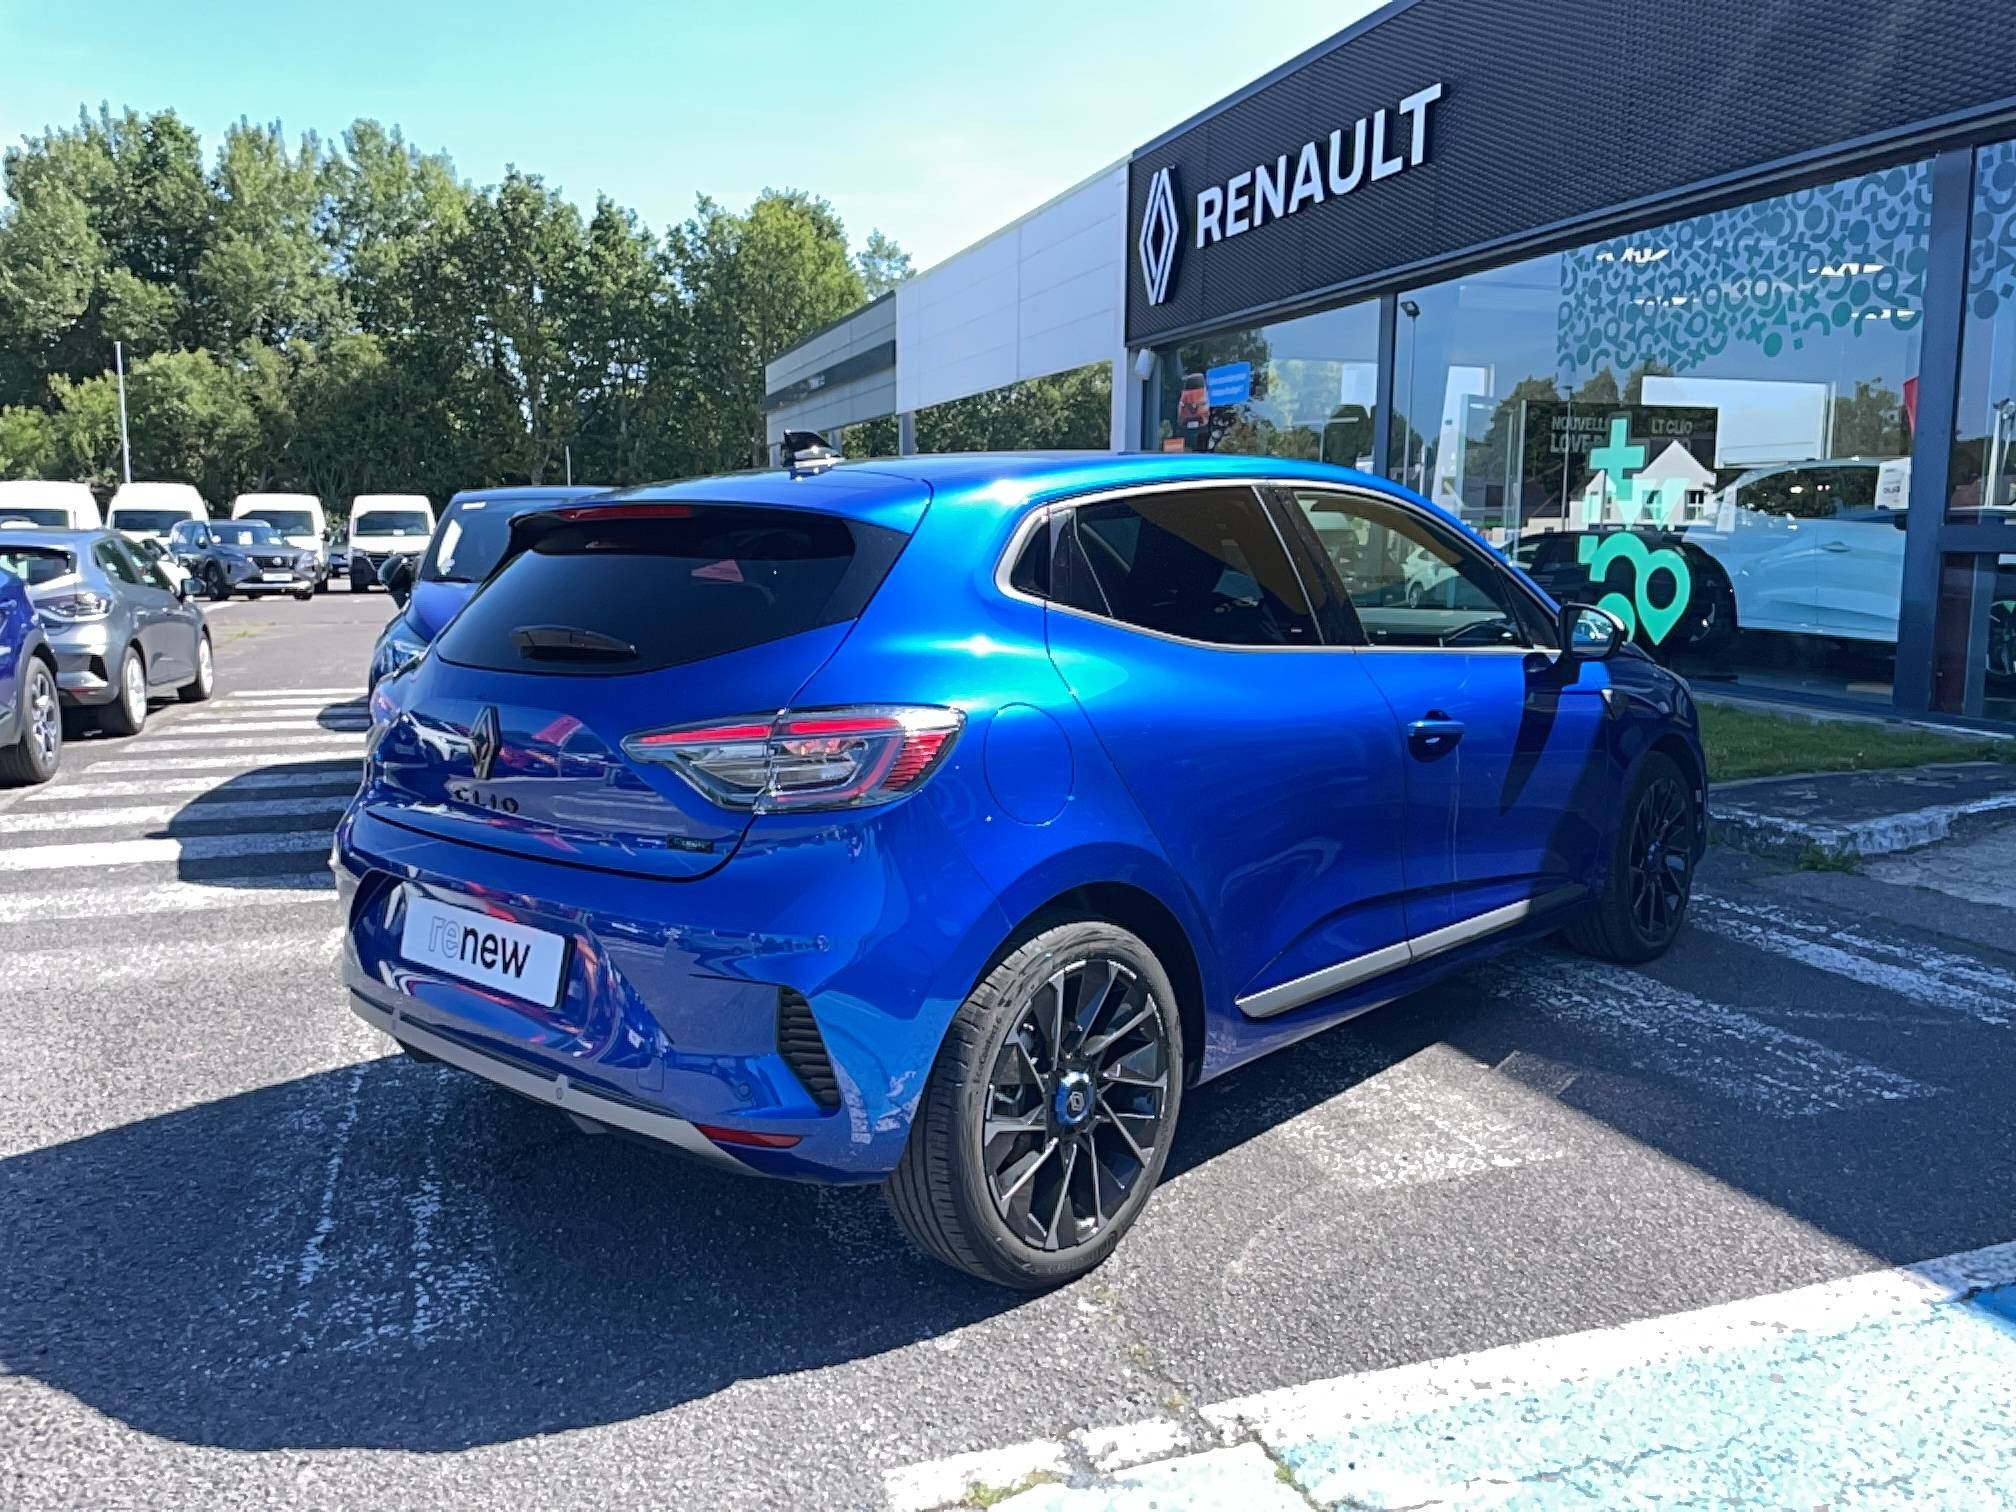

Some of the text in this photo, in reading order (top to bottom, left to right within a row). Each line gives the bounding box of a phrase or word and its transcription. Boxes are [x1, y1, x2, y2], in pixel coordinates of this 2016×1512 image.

[1196, 82, 1442, 249] RENAULT
[1551, 415, 1609, 431] NOUVELL
[1665, 418, 1693, 434] CLIO
[454, 787, 519, 814] CLIO
[428, 915, 532, 979] renew
